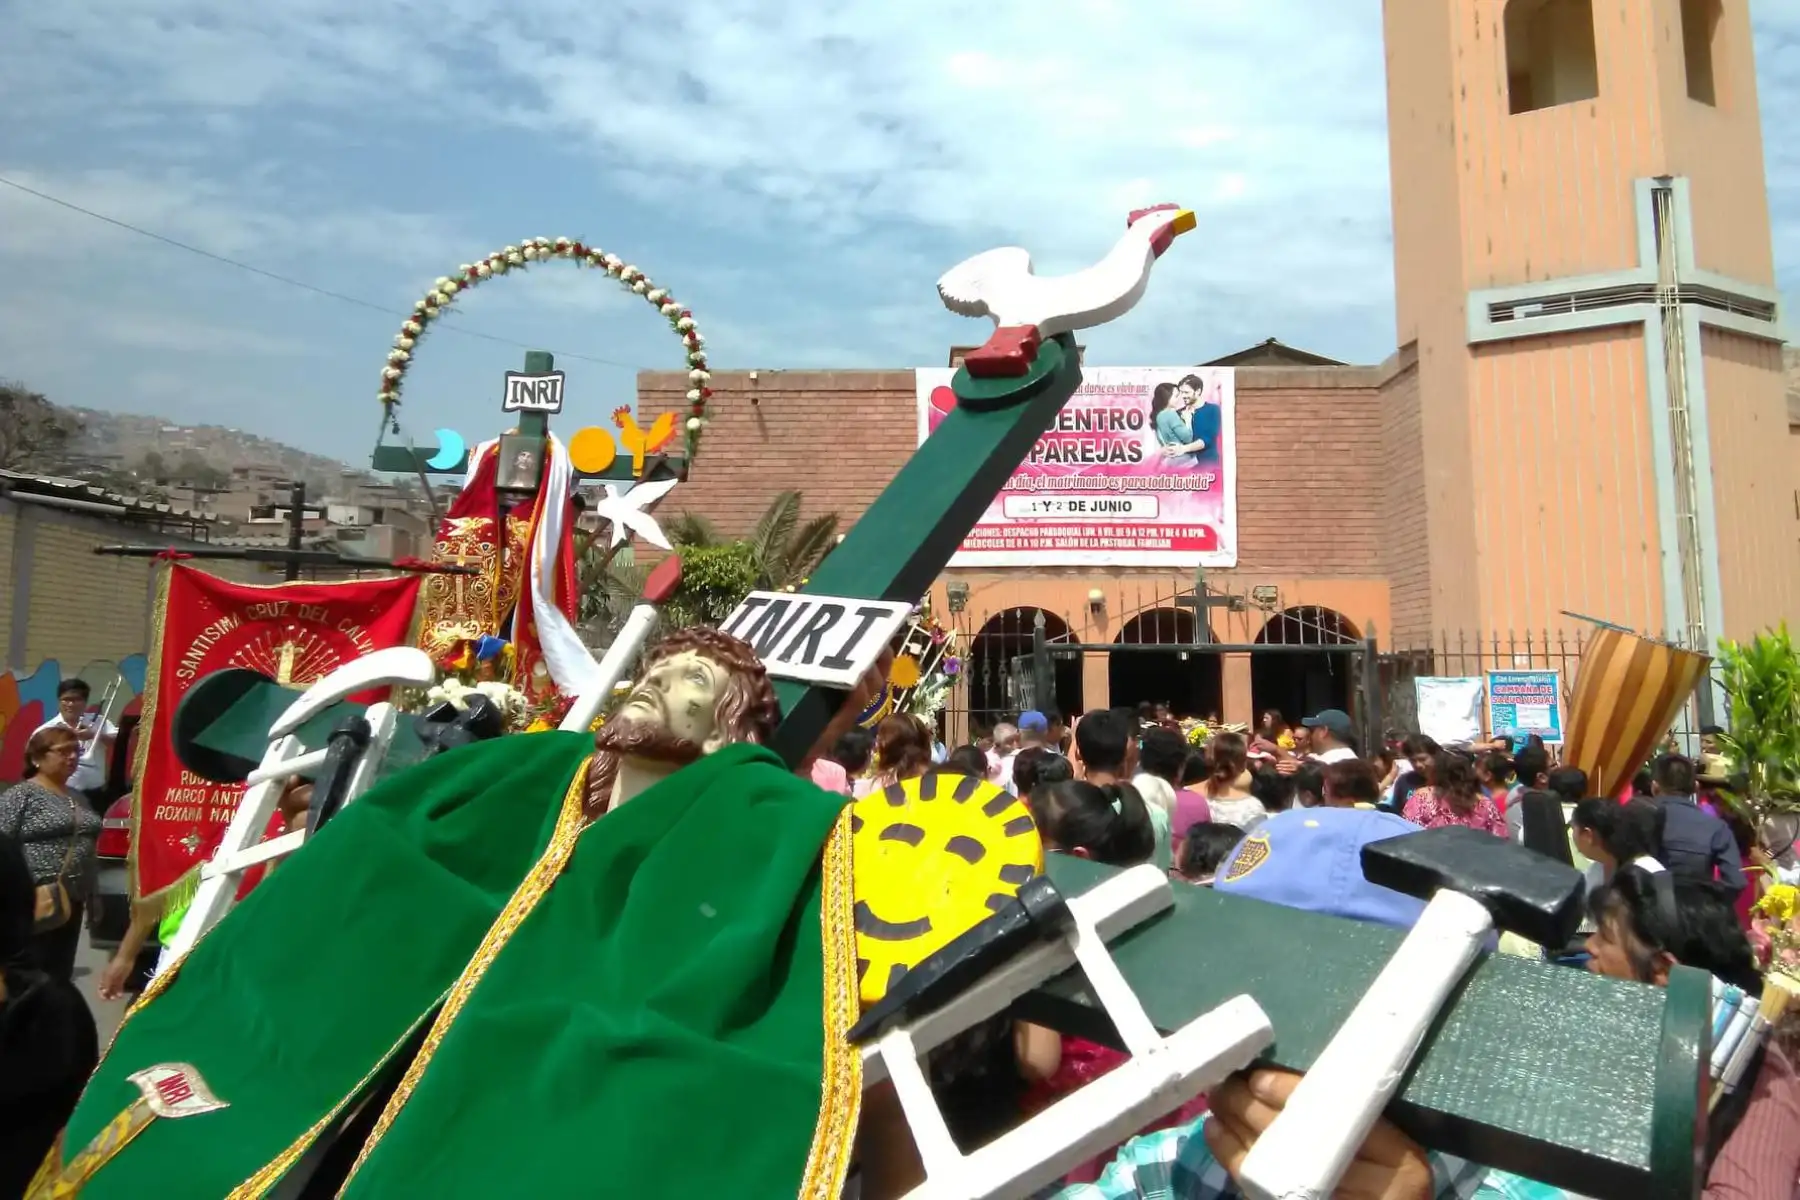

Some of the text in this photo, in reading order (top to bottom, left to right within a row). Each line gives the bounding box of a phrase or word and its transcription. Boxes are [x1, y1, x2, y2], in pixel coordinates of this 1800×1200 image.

[510, 379, 560, 404] INRI
[1030, 440, 1143, 463] PAREJAS
[1016, 473, 1035, 491] día,
[1037, 474, 1046, 489] el
[1048, 474, 1107, 490] matrimonio
[1108, 478, 1119, 489] es
[1121, 477, 1147, 492] para
[1149, 475, 1172, 490] toda
[1173, 474, 1185, 490] la
[1032, 501, 1132, 512] 1 Y 2 DE JUNIO
[1003, 527, 1039, 537] DESPACHO
[1006, 538, 1016, 548] DE
[176, 612, 244, 680] SANTISIMA
[247, 601, 291, 620] CRUZ
[299, 603, 329, 625] DEL
[724, 597, 894, 670] INRI
[165, 788, 206, 803] MARCO
[154, 805, 202, 822] ROXANA
